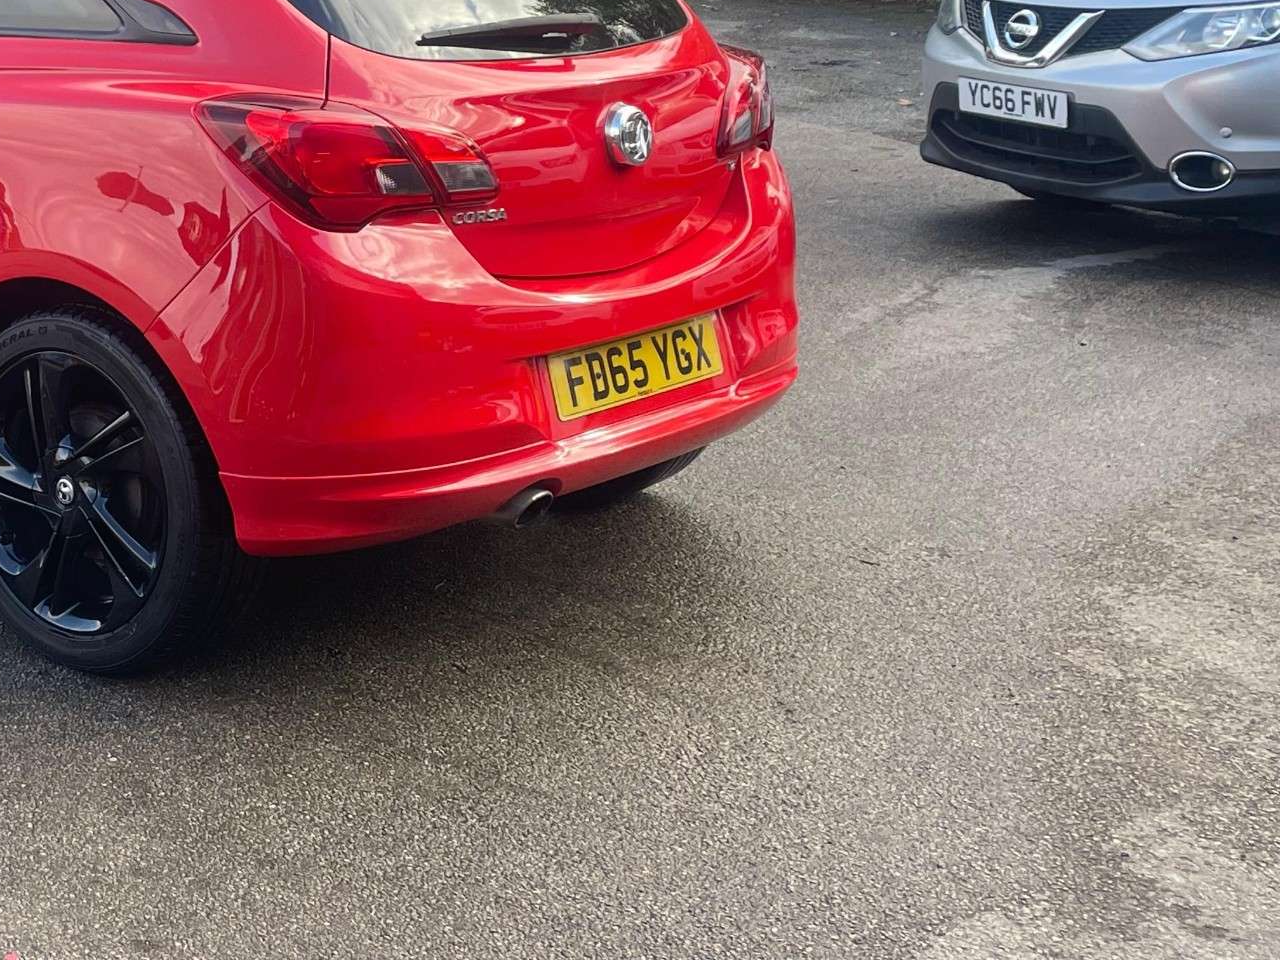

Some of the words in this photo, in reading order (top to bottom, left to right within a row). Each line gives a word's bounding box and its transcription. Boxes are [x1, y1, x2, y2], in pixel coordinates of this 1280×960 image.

[968, 81, 1016, 112] YC66
[1021, 90, 1058, 119] FWV
[452, 207, 508, 225] CORSA
[563, 339, 649, 408] FD65
[650, 323, 712, 381] YGX
